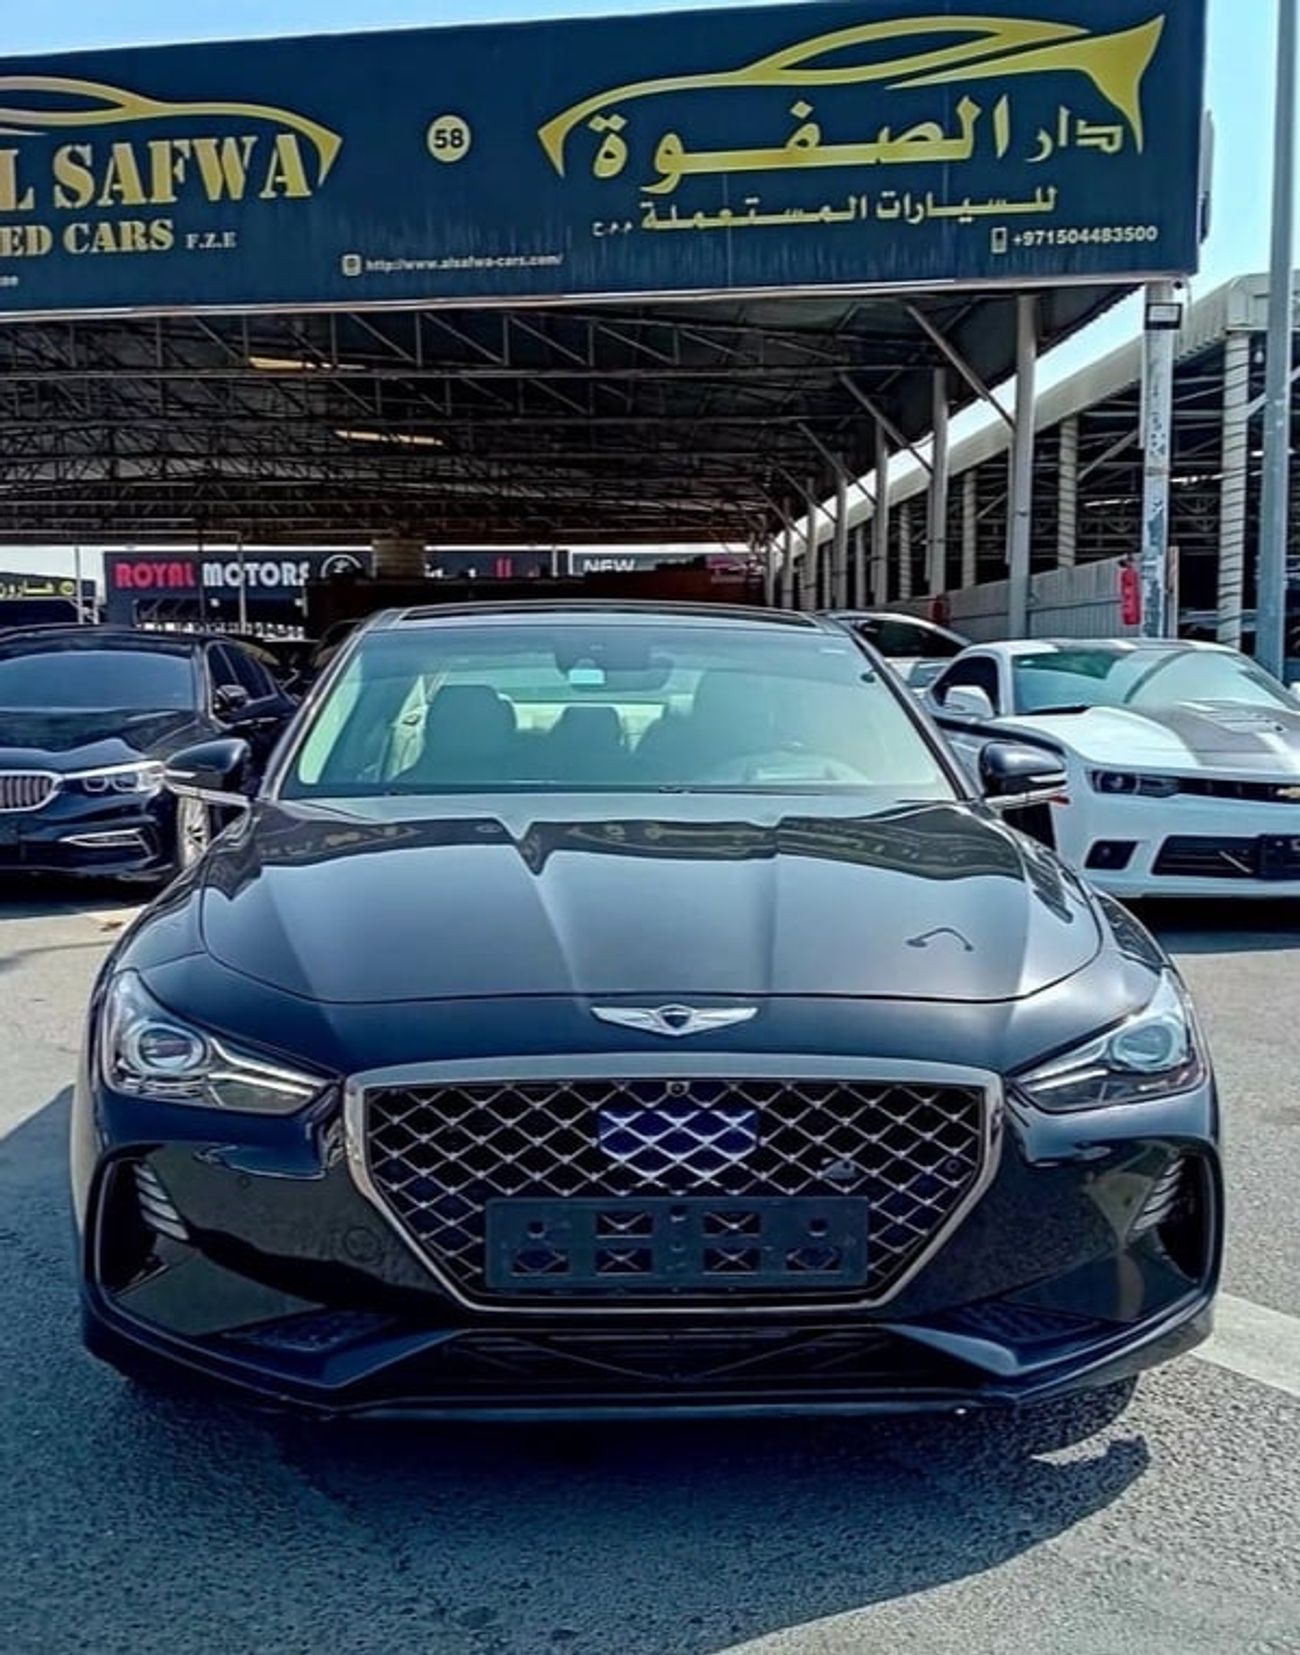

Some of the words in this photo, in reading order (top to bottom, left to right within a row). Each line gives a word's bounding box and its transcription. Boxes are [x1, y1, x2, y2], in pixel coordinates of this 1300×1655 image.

[433, 128, 465, 150] 58
[587, 94, 1012, 195] الصفوة
[1025, 105, 1123, 163] دار
[0, 149, 35, 211] L
[53, 133, 313, 209] SAFWA
[640, 194, 868, 230] المستعملة
[876, 186, 1058, 224] للسيارات
[62, 218, 175, 254] CARS
[1013, 225, 1159, 246] +971504483500
[115, 562, 196, 588] ROYAL
